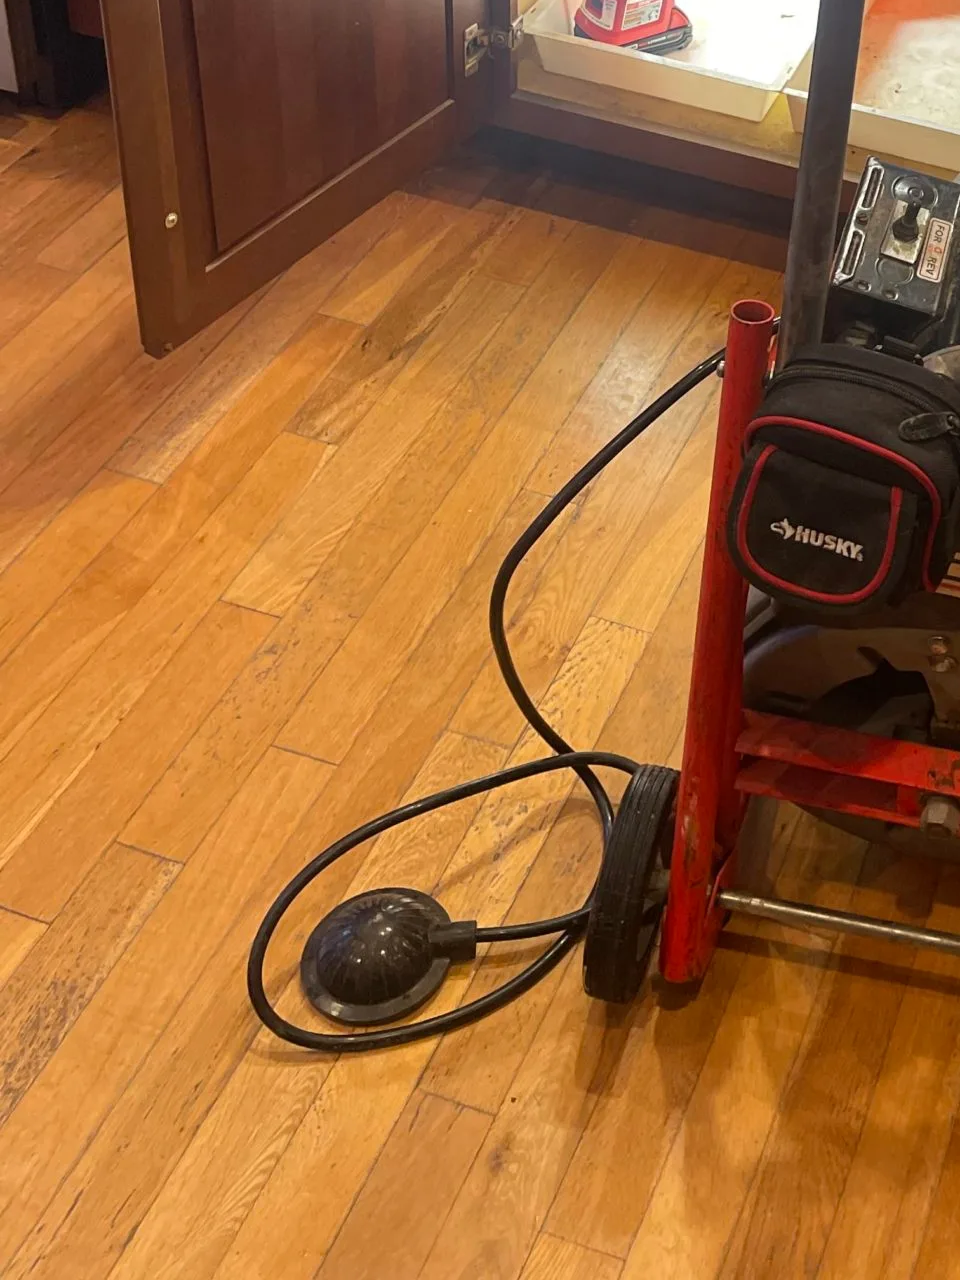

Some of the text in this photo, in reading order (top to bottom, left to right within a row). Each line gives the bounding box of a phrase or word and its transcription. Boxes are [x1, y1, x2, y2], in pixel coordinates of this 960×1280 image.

[932, 224, 945, 242] FOR
[926, 255, 938, 276] REV
[794, 524, 861, 560] HUSKY
